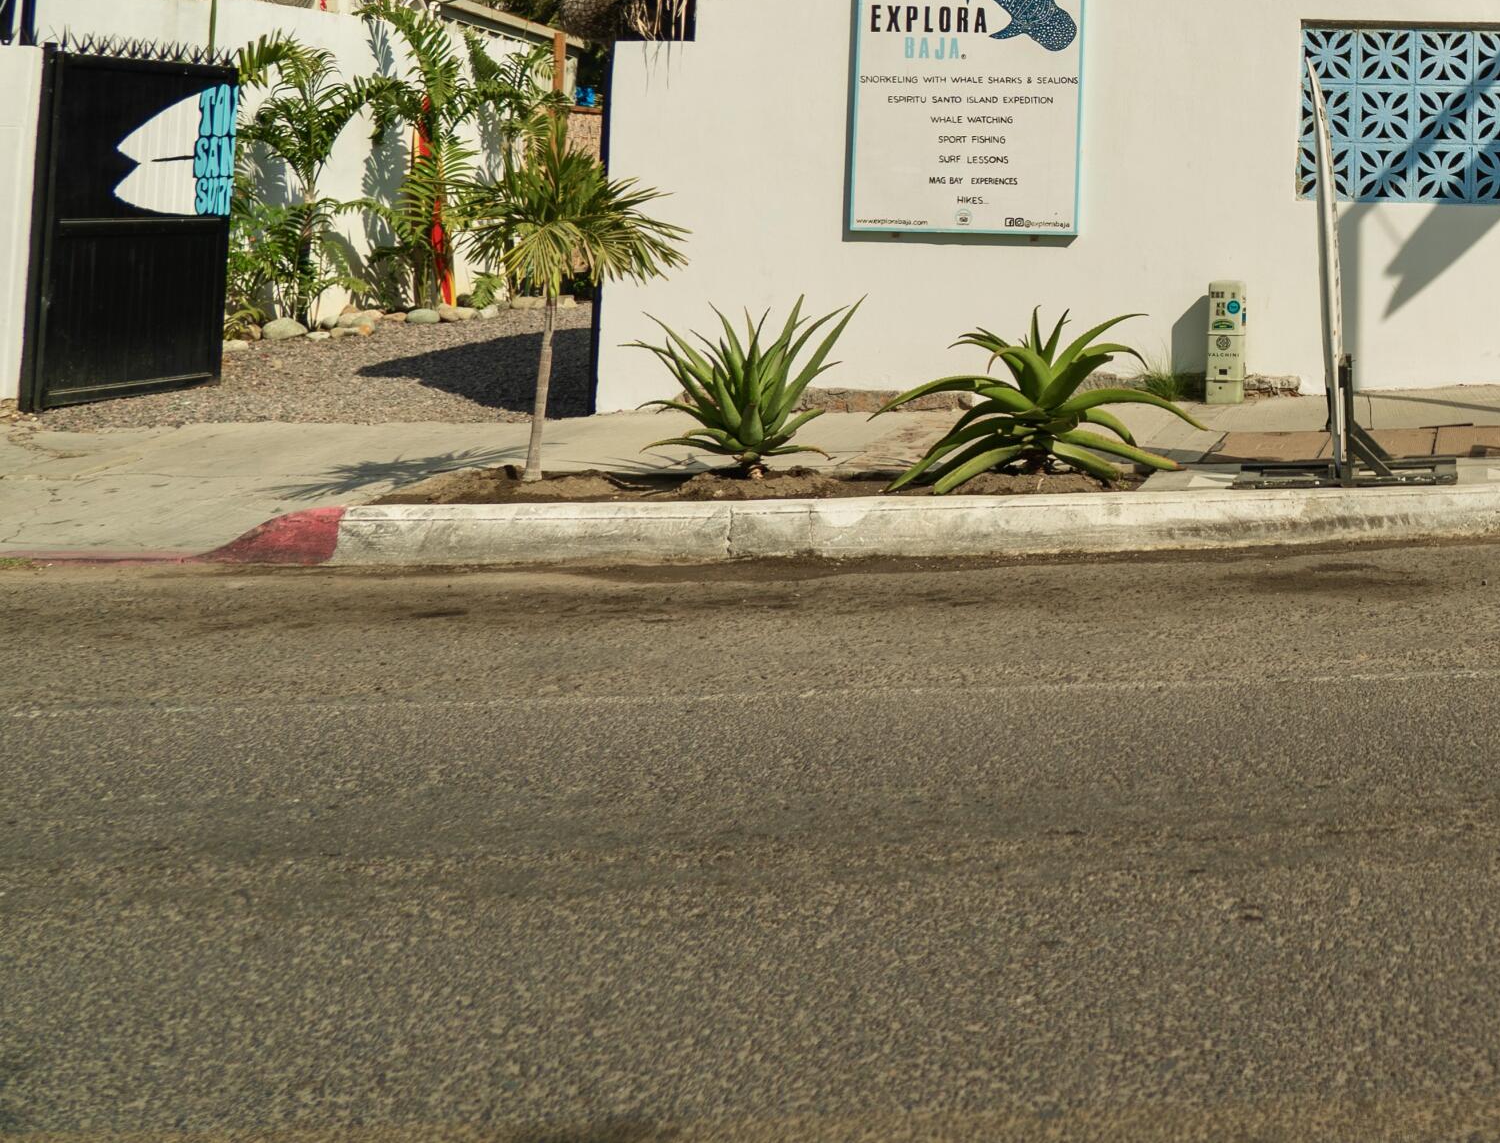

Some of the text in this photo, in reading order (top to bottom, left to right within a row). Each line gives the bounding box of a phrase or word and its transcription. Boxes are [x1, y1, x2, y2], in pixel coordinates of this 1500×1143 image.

[870, 4, 987, 33] EXPLORA
[904, 37, 959, 60] BAJA
[859, 75, 1079, 85] SNORKELING WITH WHALE SHARKS & SEALIONS
[887, 95, 1054, 105] ESPIRITU SANTO ISLAND EXPEDITION
[930, 115, 1014, 125] WHALE WATCHING
[938, 135, 1006, 145] SPORT FISHING
[938, 155, 1009, 164] SURF LESSONS
[928, 176, 1018, 186] MAG BAY EXPERIENCES
